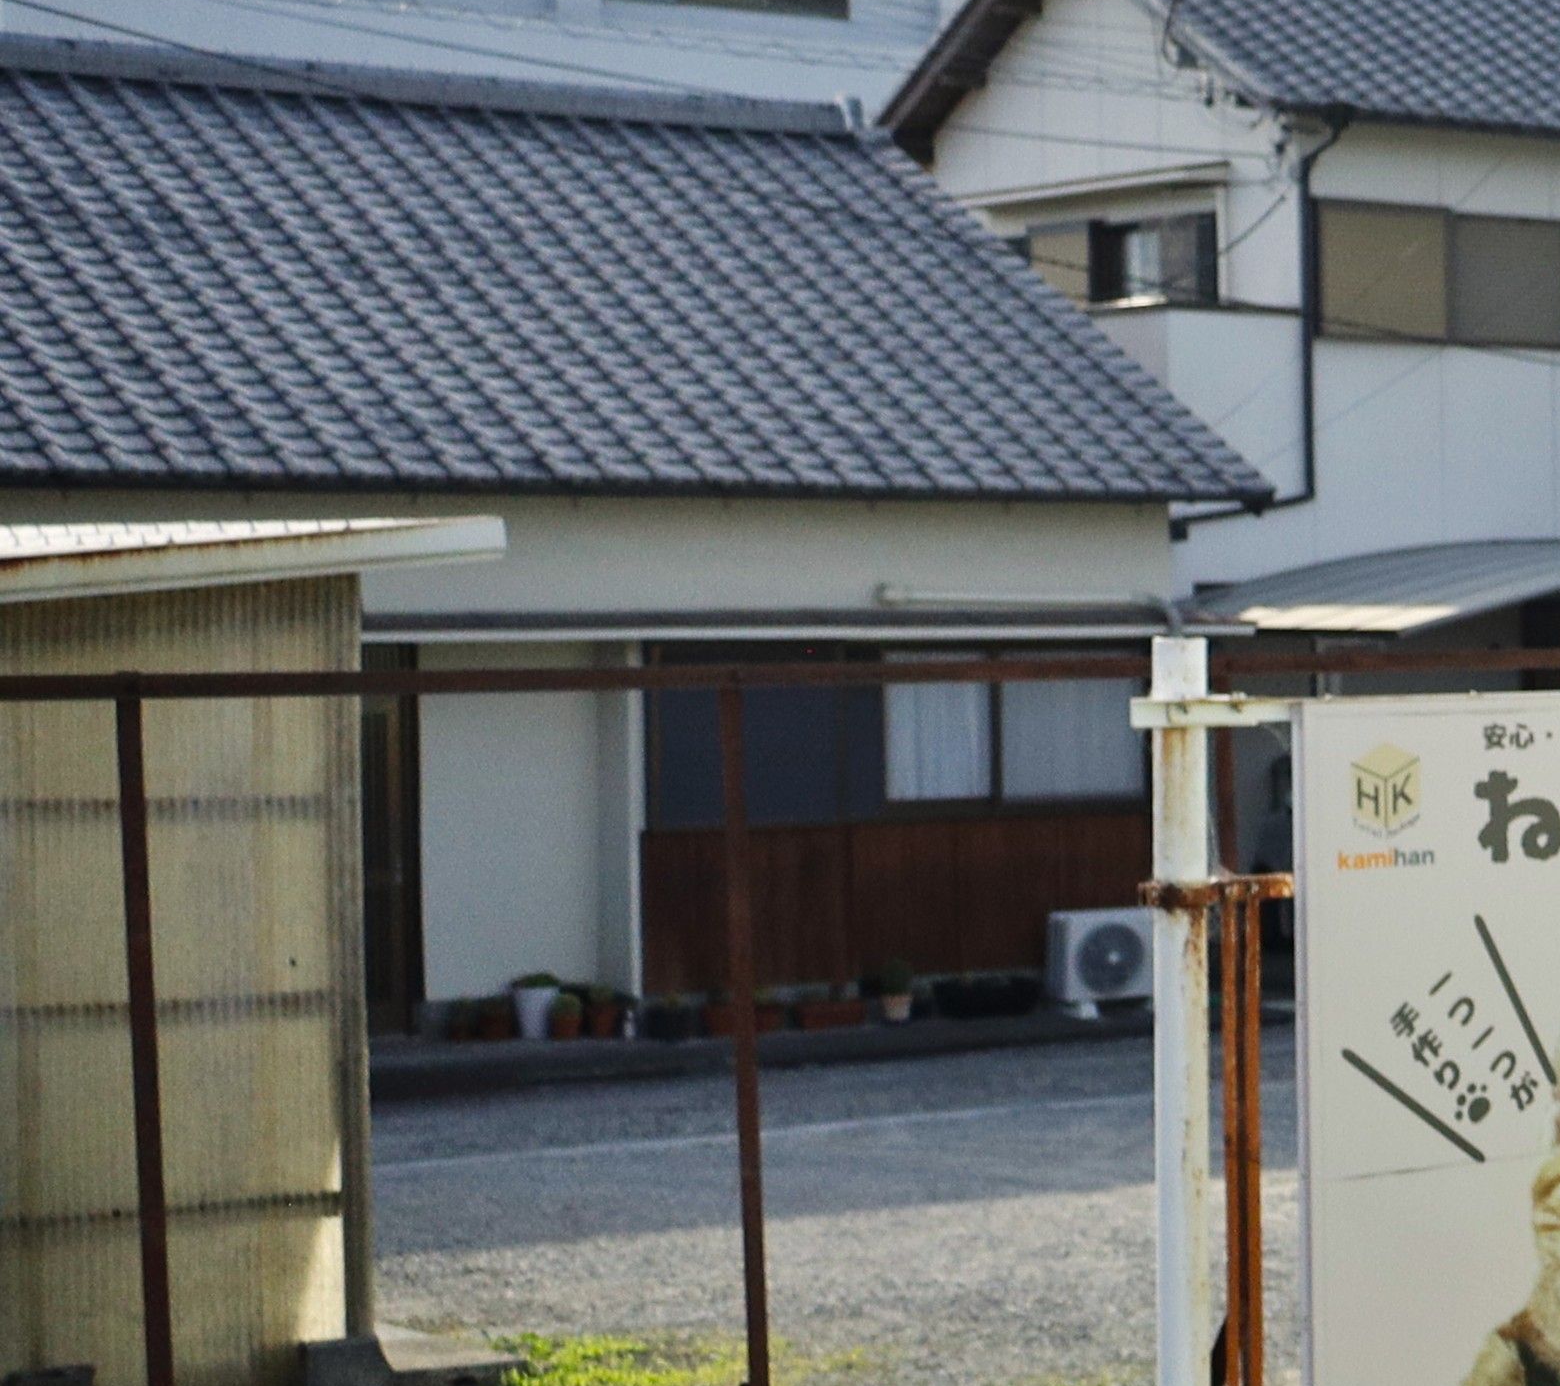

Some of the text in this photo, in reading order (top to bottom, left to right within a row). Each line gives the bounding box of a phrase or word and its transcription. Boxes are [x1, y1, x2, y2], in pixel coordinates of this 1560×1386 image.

[1337, 848, 1435, 870] kamihan
[1390, 1001, 1460, 1091] 手作り
